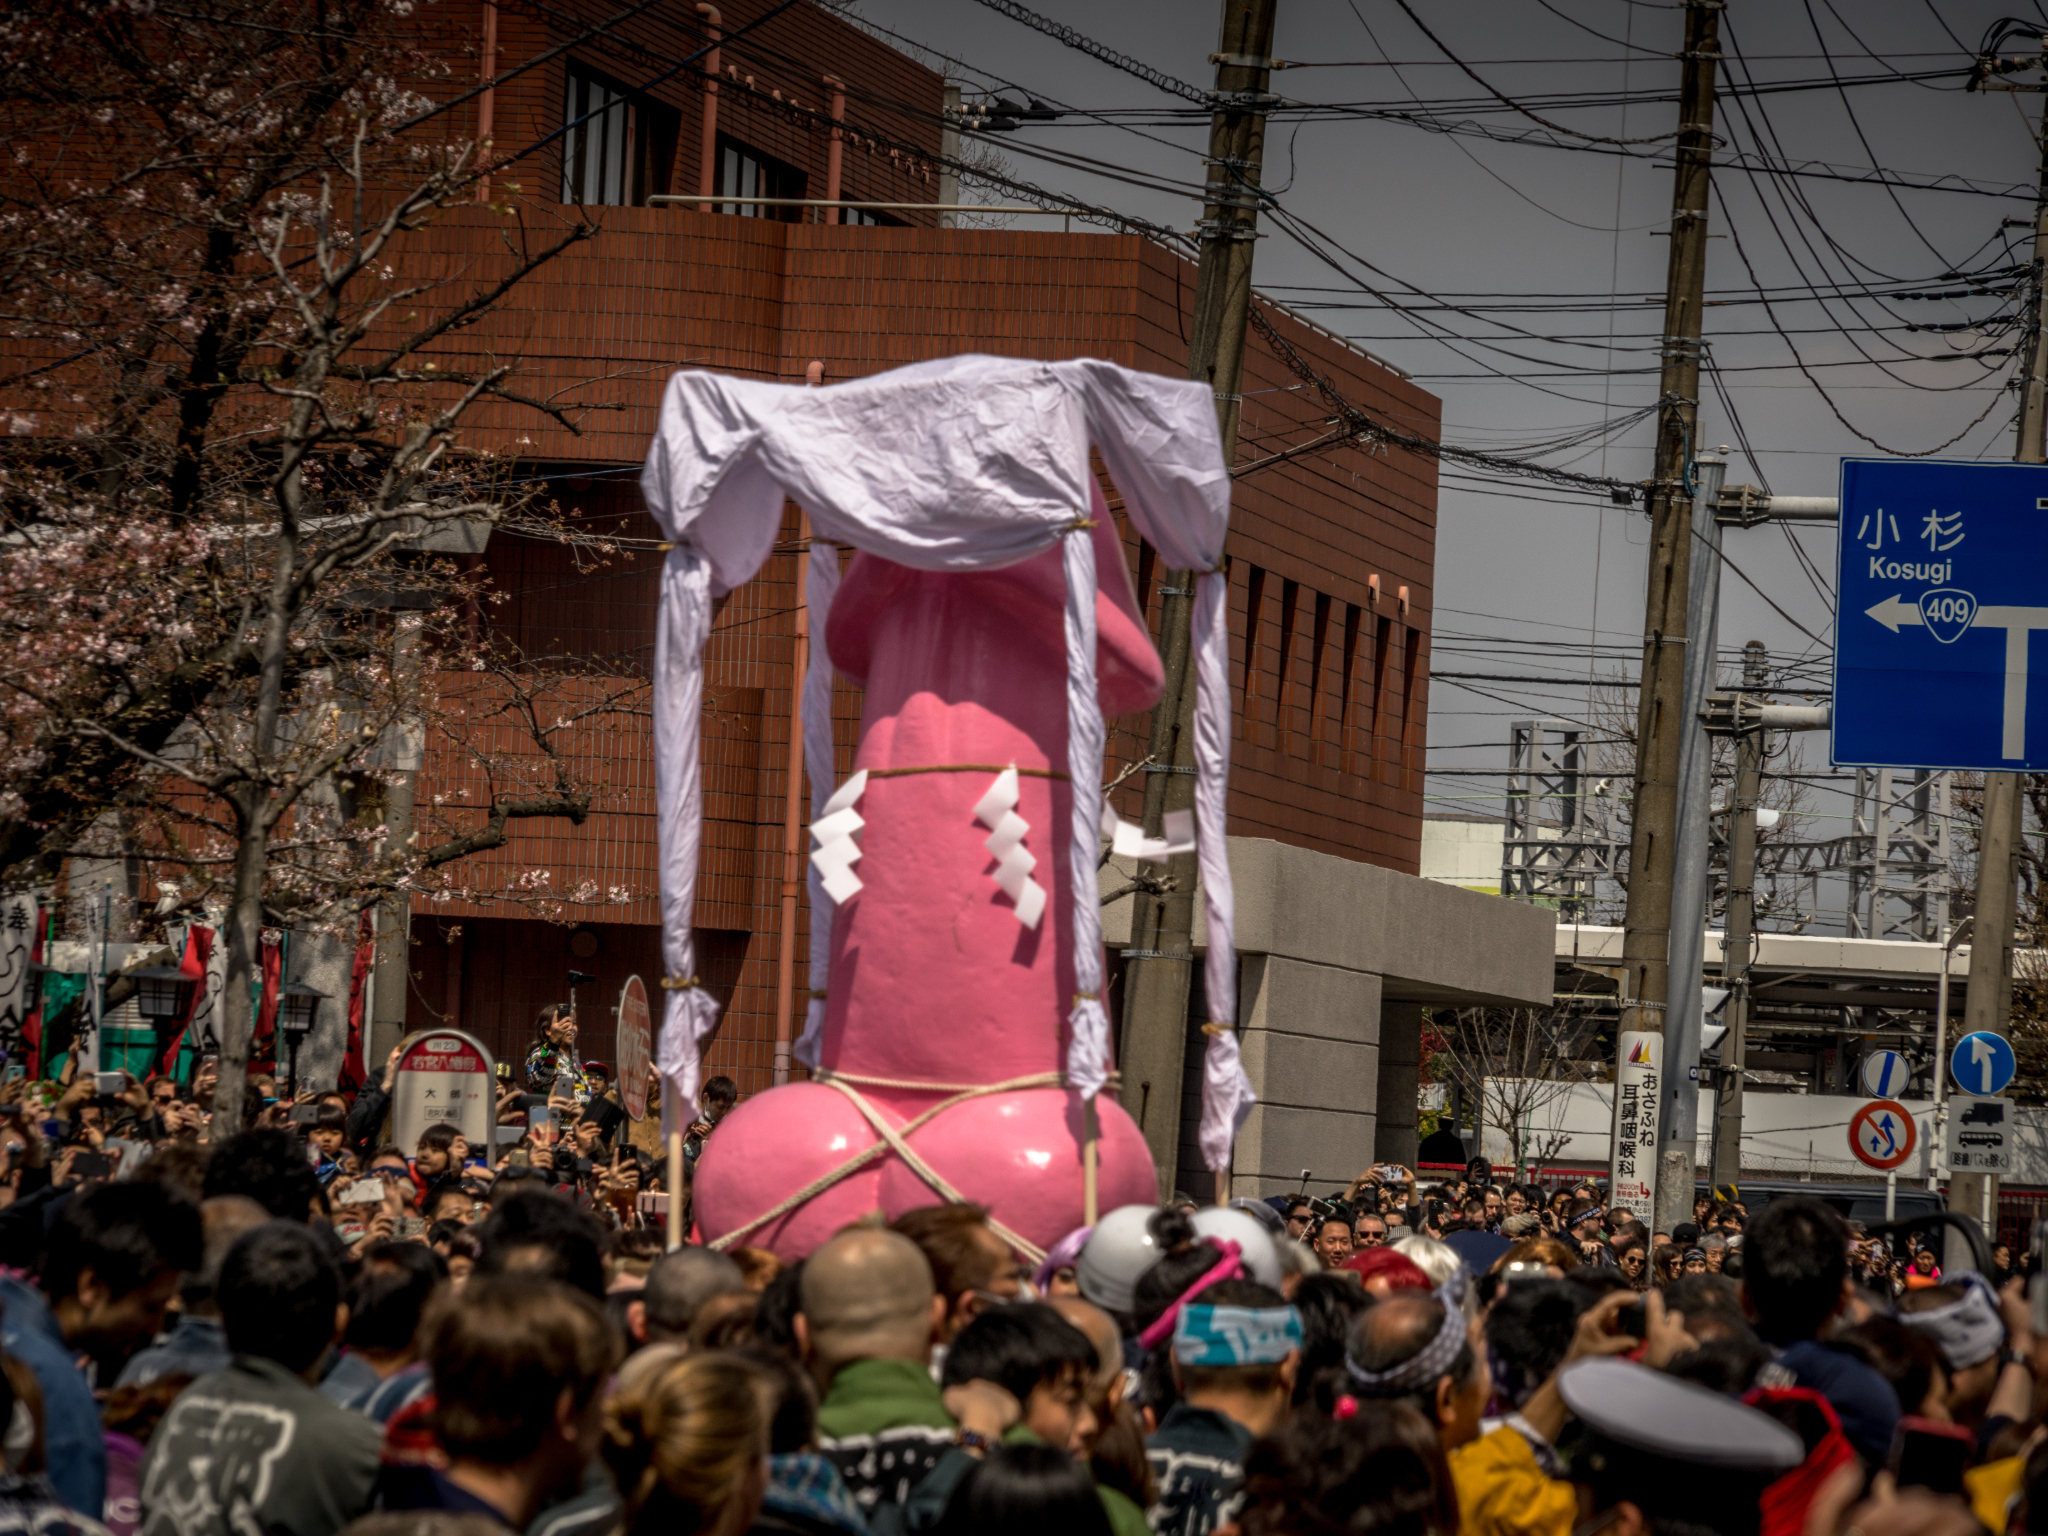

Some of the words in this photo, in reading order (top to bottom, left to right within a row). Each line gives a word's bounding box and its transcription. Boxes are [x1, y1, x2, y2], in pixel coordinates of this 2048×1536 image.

[1857, 508, 1965, 552] 小杉
[1869, 556, 1952, 585] Kosugi
[1926, 598, 1969, 623] 409
[1618, 1084, 1640, 1179] 耳鼻咽喉科
[1639, 1072, 1658, 1147] おさふね
